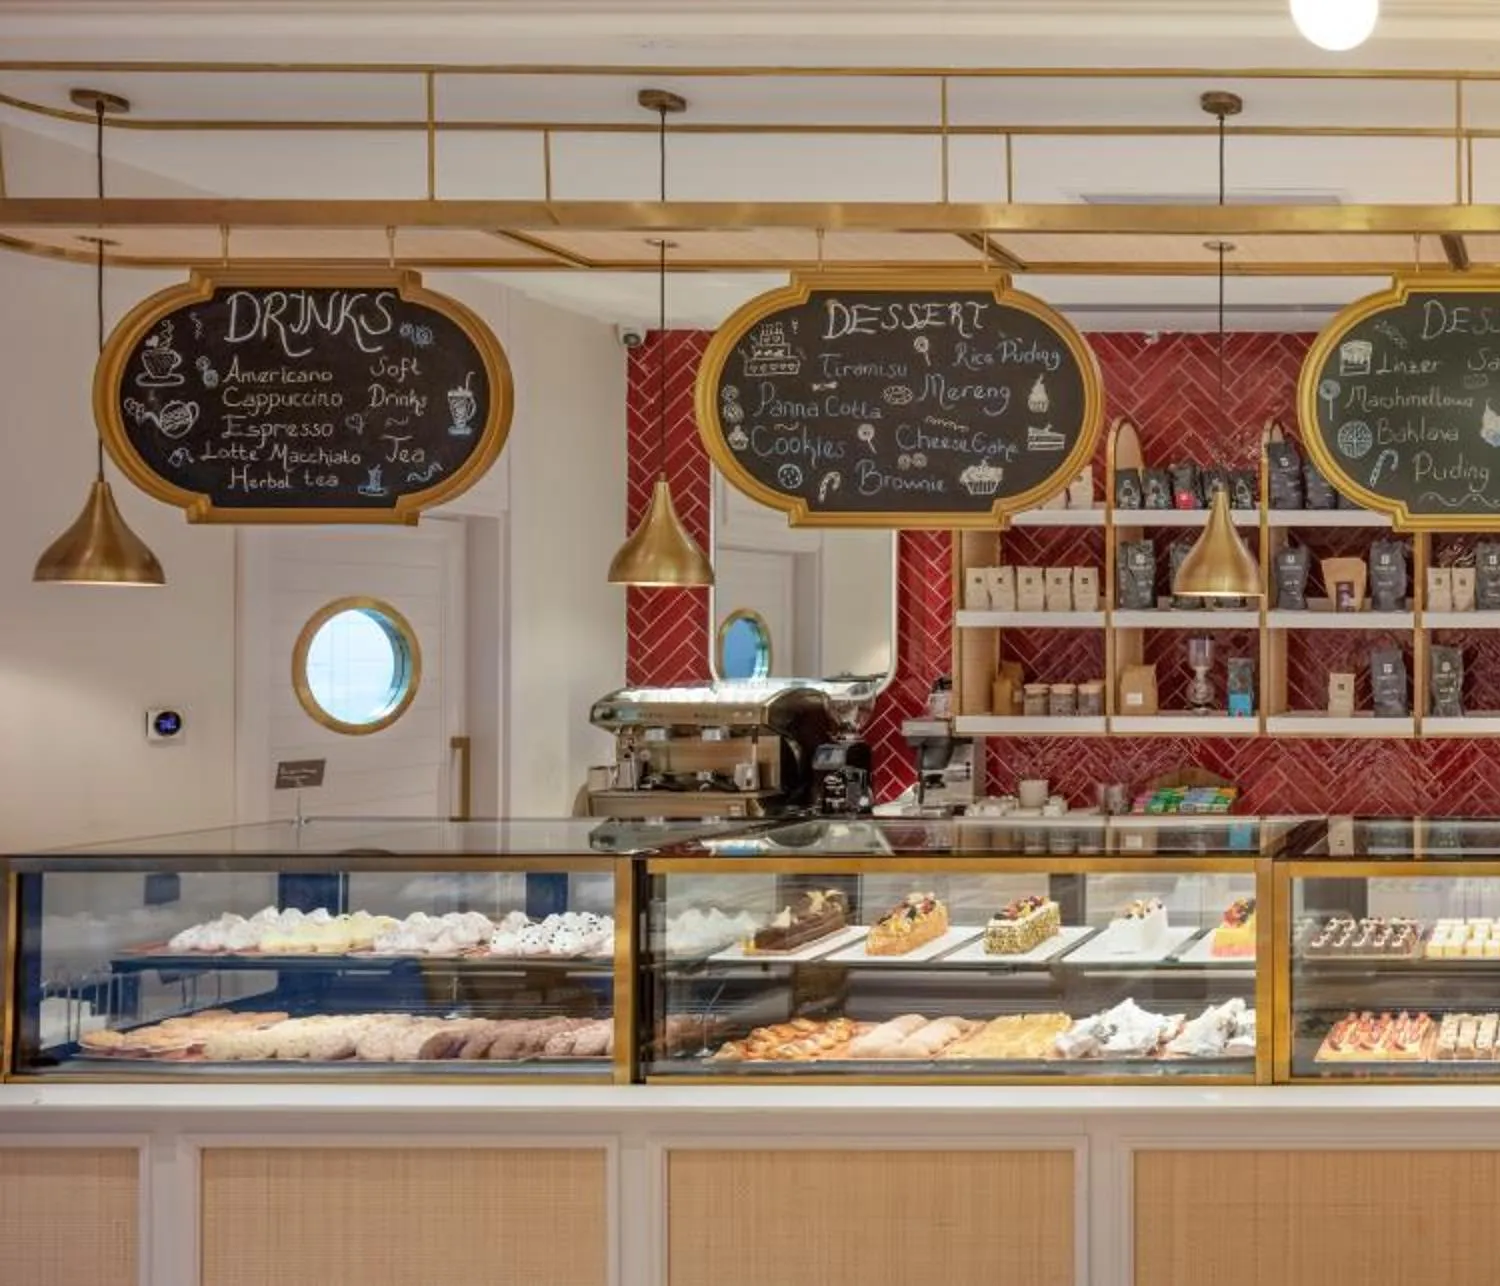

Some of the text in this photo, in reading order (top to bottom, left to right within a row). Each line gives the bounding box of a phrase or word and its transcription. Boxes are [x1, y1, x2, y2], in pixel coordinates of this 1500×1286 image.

[224, 291, 397, 357] DRINKS
[823, 301, 989, 341] DESSERT
[222, 354, 334, 383] Americano
[369, 356, 422, 382] Soft
[818, 353, 908, 378] Tiramisu
[952, 341, 995, 371] Rice
[1376, 351, 1440, 374] Linzer
[222, 385, 343, 416] Cappuccino
[367, 383, 428, 416] Drinks
[753, 381, 882, 419] Panna Cotta
[916, 373, 1011, 416] Mereng
[221, 414, 335, 449] Espresso
[751, 425, 846, 469] Cookies
[269, 443, 361, 473] Macchiato
[382, 434, 425, 462] Tea
[227, 464, 339, 493] Herbal tea
[855, 459, 946, 496] Brownie
[1412, 451, 1489, 493] Puding
